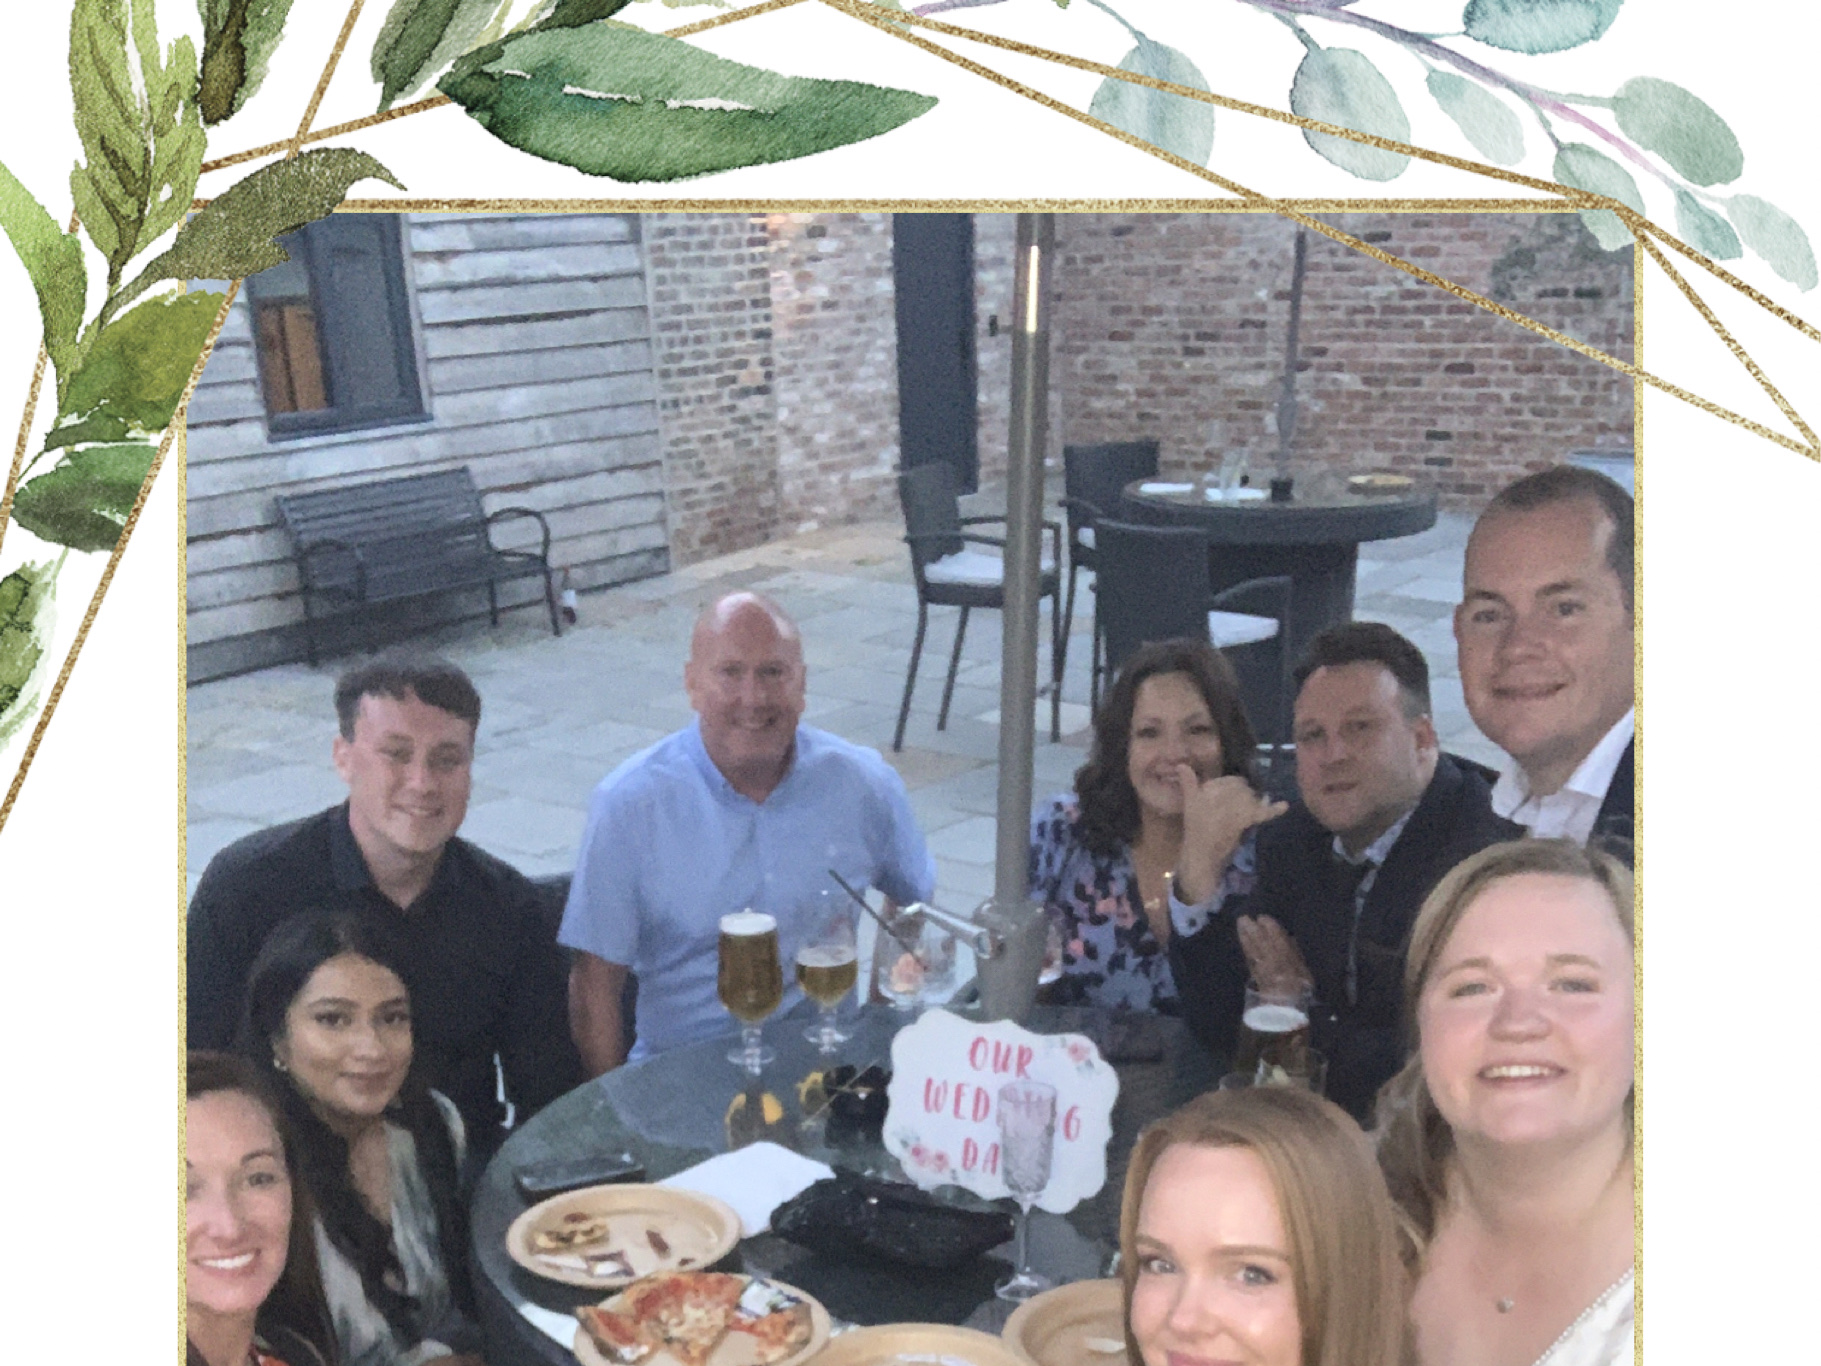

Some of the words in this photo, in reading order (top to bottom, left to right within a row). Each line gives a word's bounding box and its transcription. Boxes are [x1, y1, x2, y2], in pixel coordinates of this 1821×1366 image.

[969, 1036, 1034, 1079] OUR
[923, 1077, 1081, 1142] WEDG
[961, 1137, 1006, 1175] DA
